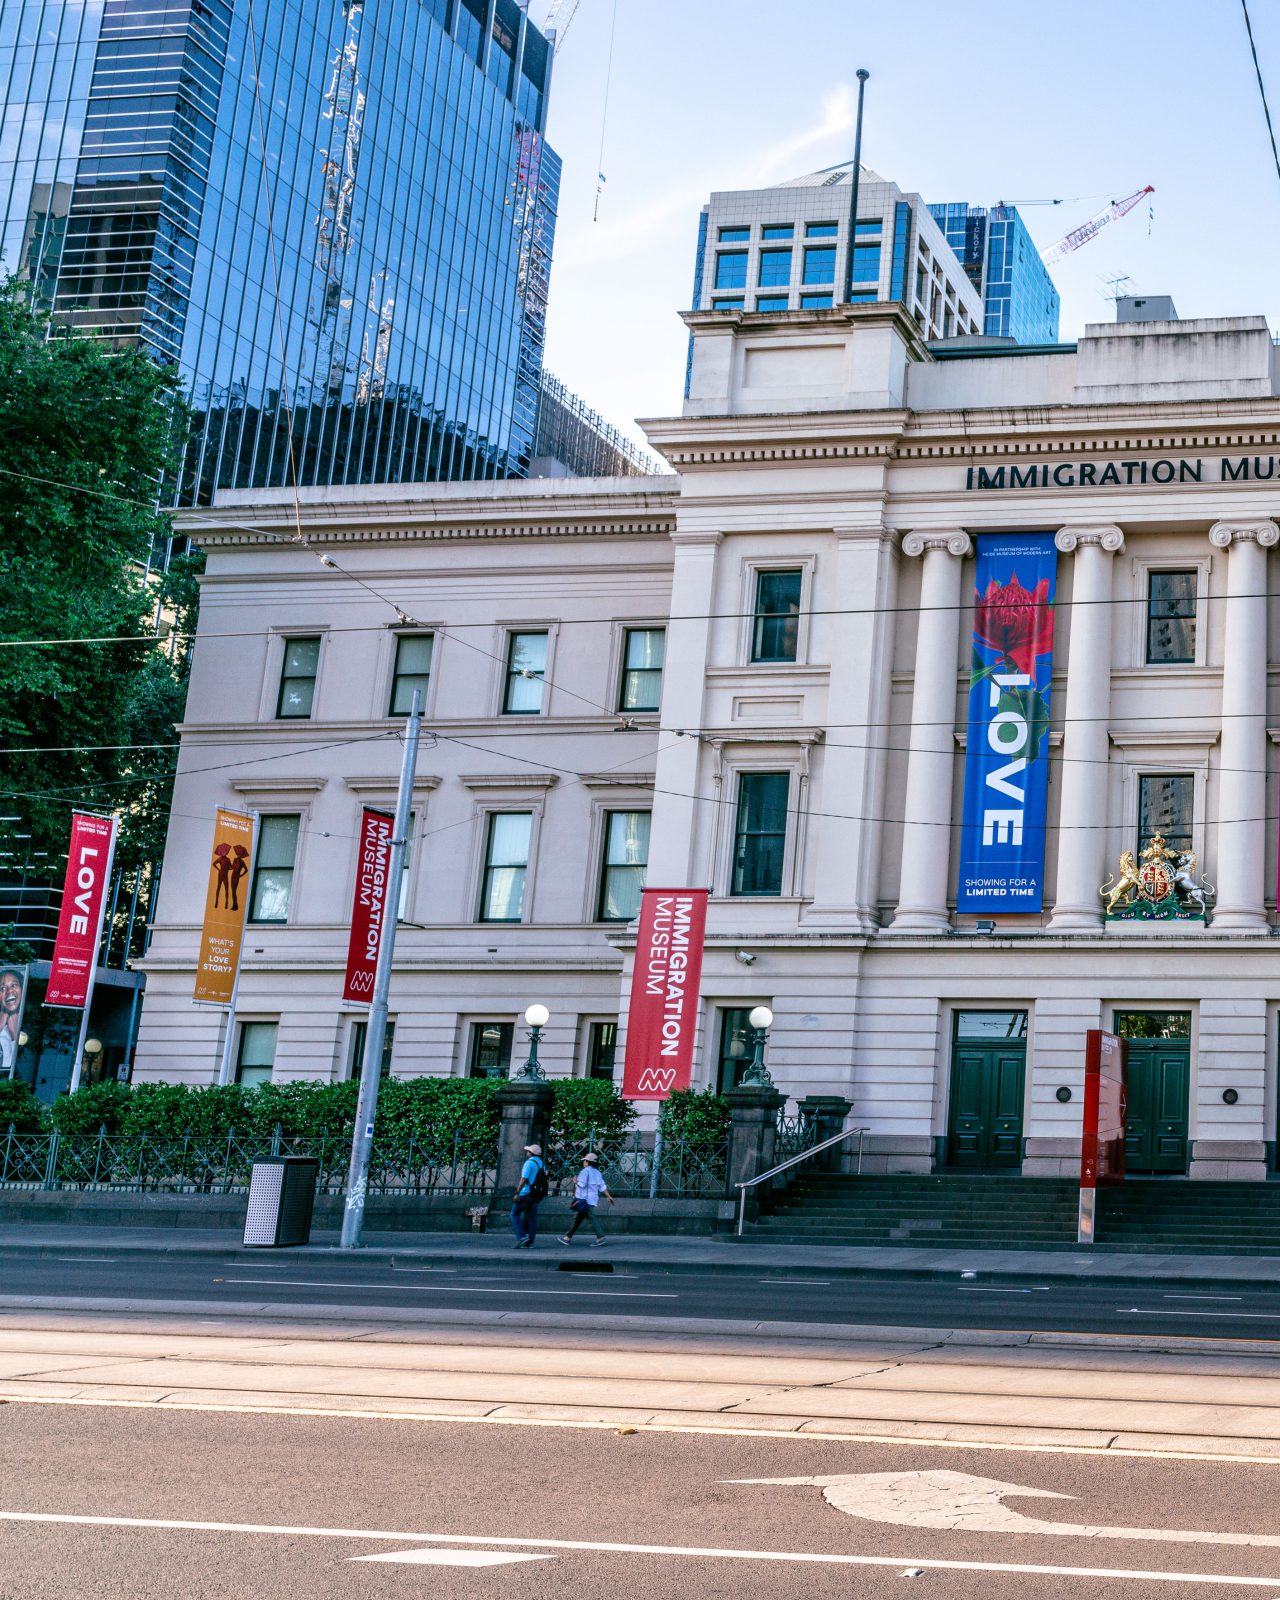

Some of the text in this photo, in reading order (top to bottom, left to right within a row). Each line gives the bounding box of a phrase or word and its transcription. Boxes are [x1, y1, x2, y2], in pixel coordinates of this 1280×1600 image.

[966, 459, 1202, 490] IMMIGRATION
[983, 674, 1030, 846] LOVE
[360, 819, 379, 905] MUSEUM
[70, 847, 98, 935] LOVE
[366, 821, 390, 961] IMMIGRATION
[965, 879, 1007, 887] SHOWING
[1009, 879, 1027, 887] FOR
[966, 888, 1034, 896] LIMITED TIME
[208, 937, 235, 947] WHAT'S
[211, 946, 230, 955] YOUR
[646, 897, 674, 995] MUSEUM
[203, 963, 232, 973] STORY?
[209, 955, 229, 964] LOVE
[660, 897, 693, 1056] IMMIGRATION
